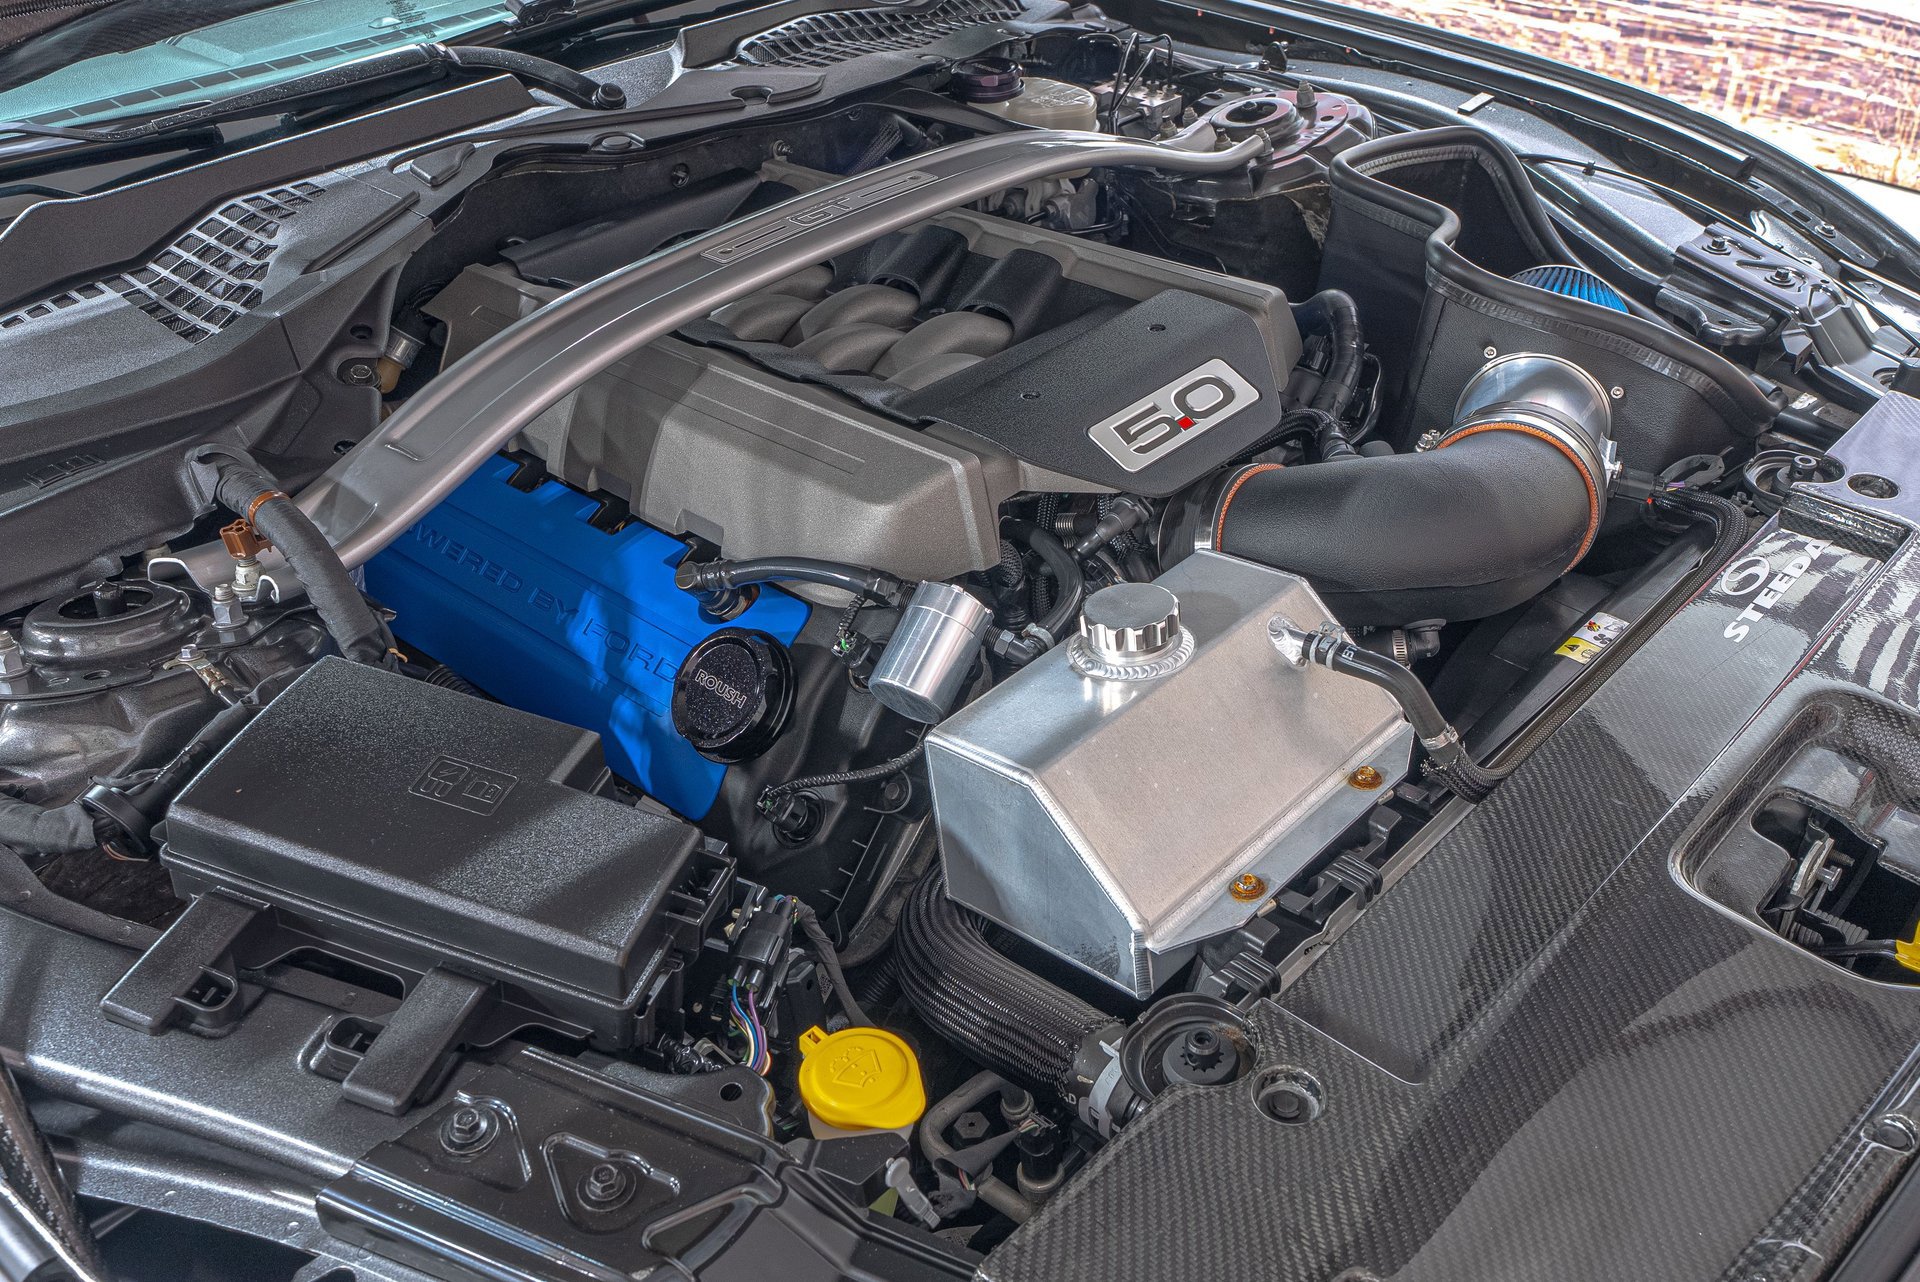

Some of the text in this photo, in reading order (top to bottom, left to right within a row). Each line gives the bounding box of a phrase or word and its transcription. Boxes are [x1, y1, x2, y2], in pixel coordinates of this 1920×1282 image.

[1110, 374, 1235, 455] 5.0
[407, 521, 680, 684] WERED BY FORD
[1723, 538, 1834, 643] STEEDA
[694, 668, 748, 710] ROUSH
